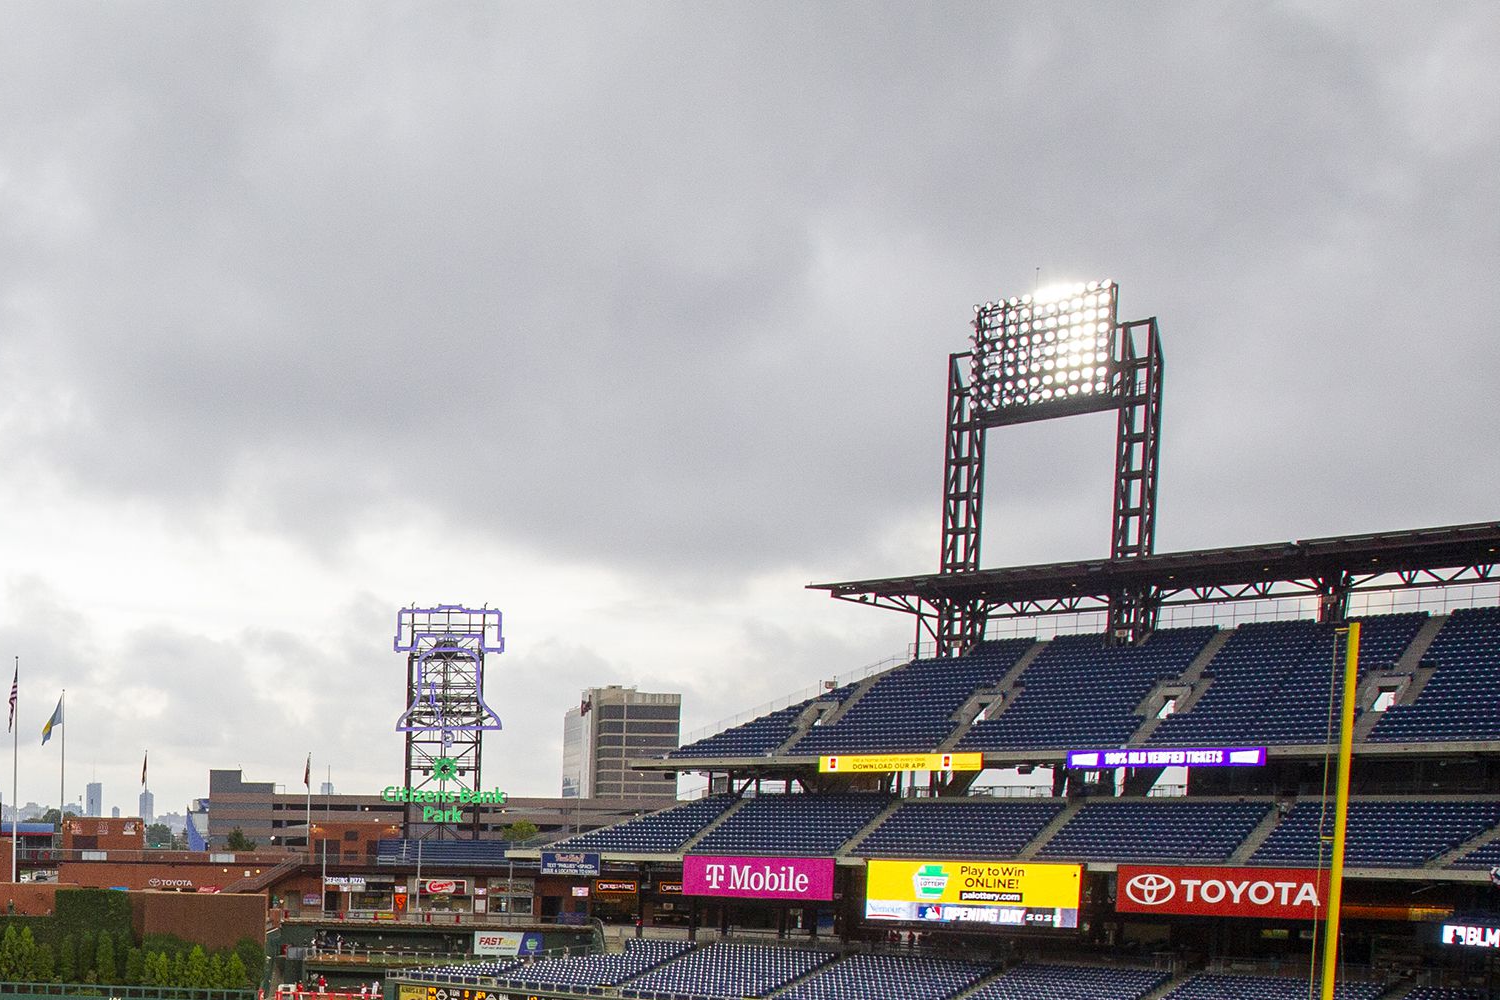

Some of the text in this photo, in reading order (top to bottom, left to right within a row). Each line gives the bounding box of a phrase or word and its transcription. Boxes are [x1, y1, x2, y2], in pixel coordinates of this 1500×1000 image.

[1147, 752, 1185, 764] VERIFIED
[1186, 751, 1223, 764] TICKETS
[383, 786, 505, 804] Citizens Bank
[423, 805, 463, 823] Park
[729, 865, 809, 892] Mobile
[960, 866, 1025, 877] Play to Win
[349, 877, 365, 885] PIZZA
[964, 878, 1019, 889] ONLINE!
[961, 891, 1021, 902] palottery.com
[1181, 879, 1320, 907] TOYOTA
[943, 907, 998, 922] OPENING
[1000, 909, 1026, 923] DAY
[1465, 927, 1500, 947] BLM
[450, 989, 460, 997] TOR
